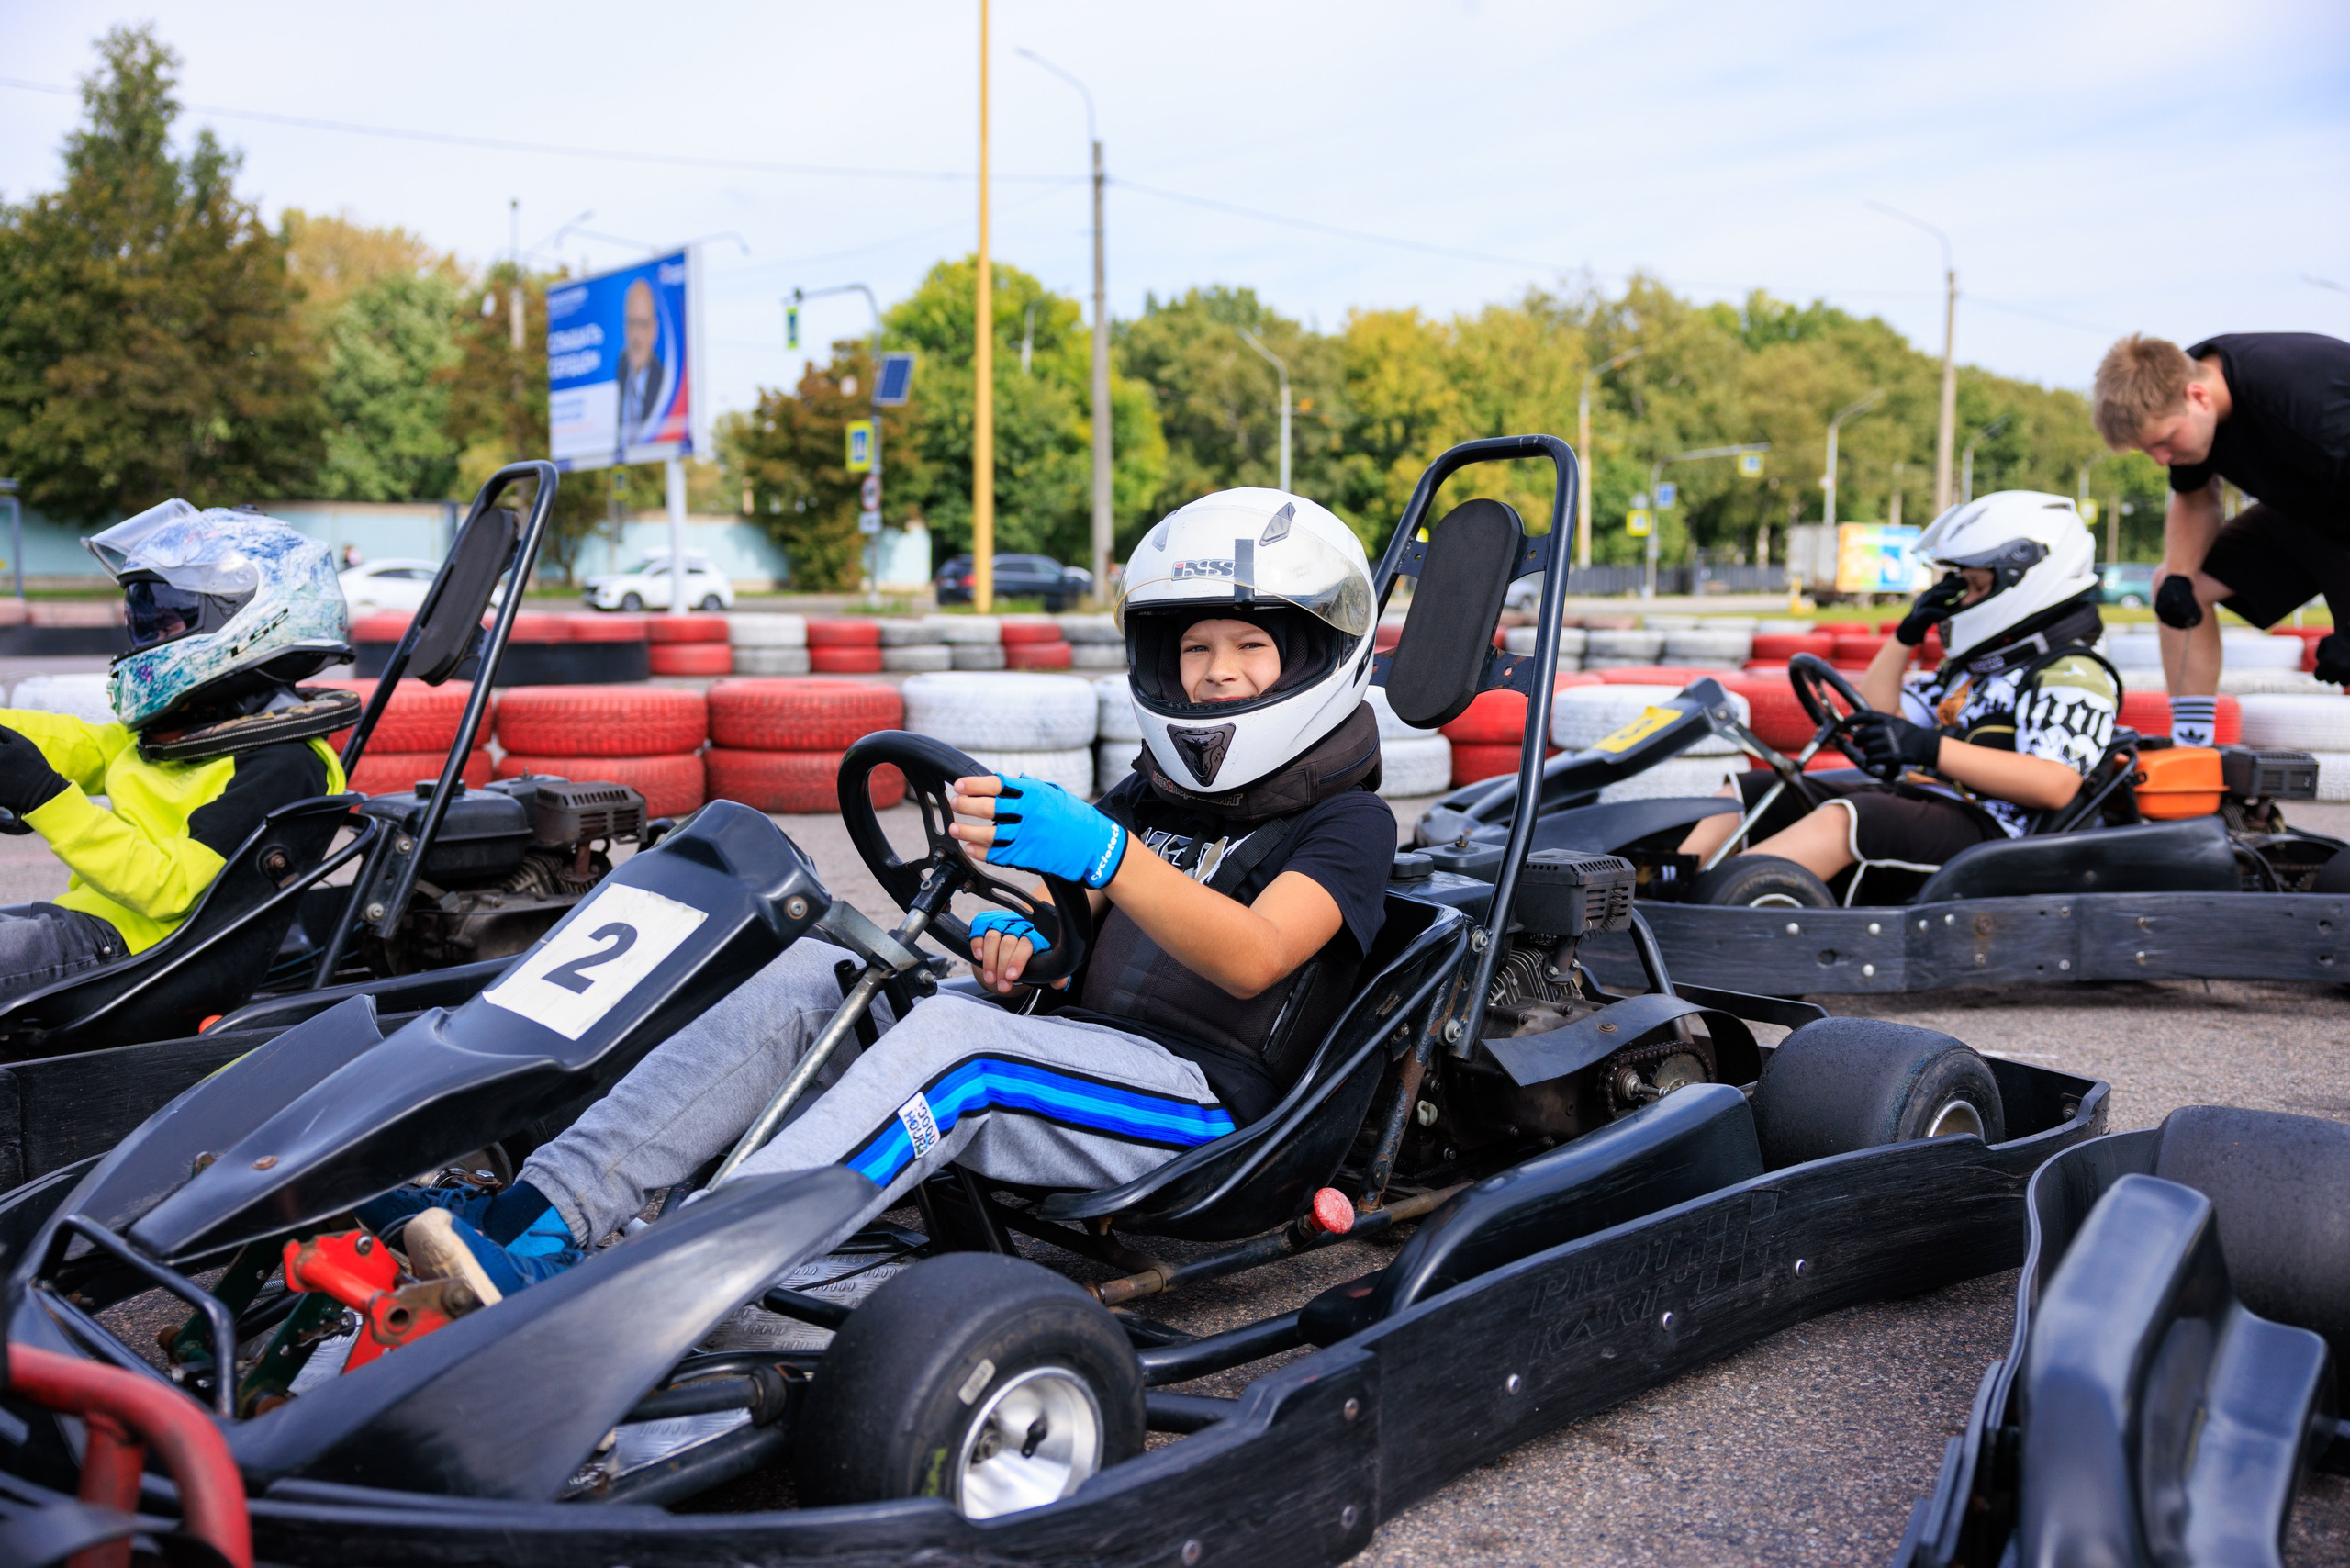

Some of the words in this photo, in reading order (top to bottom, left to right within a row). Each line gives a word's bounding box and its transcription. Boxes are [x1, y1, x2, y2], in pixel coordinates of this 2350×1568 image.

[230, 608, 290, 657] LS2
[1091, 823, 1119, 881] cyclotech
[542, 922, 638, 995] 2
[1529, 1236, 1681, 1318] PILOT
[1528, 1281, 1669, 1365] KART
